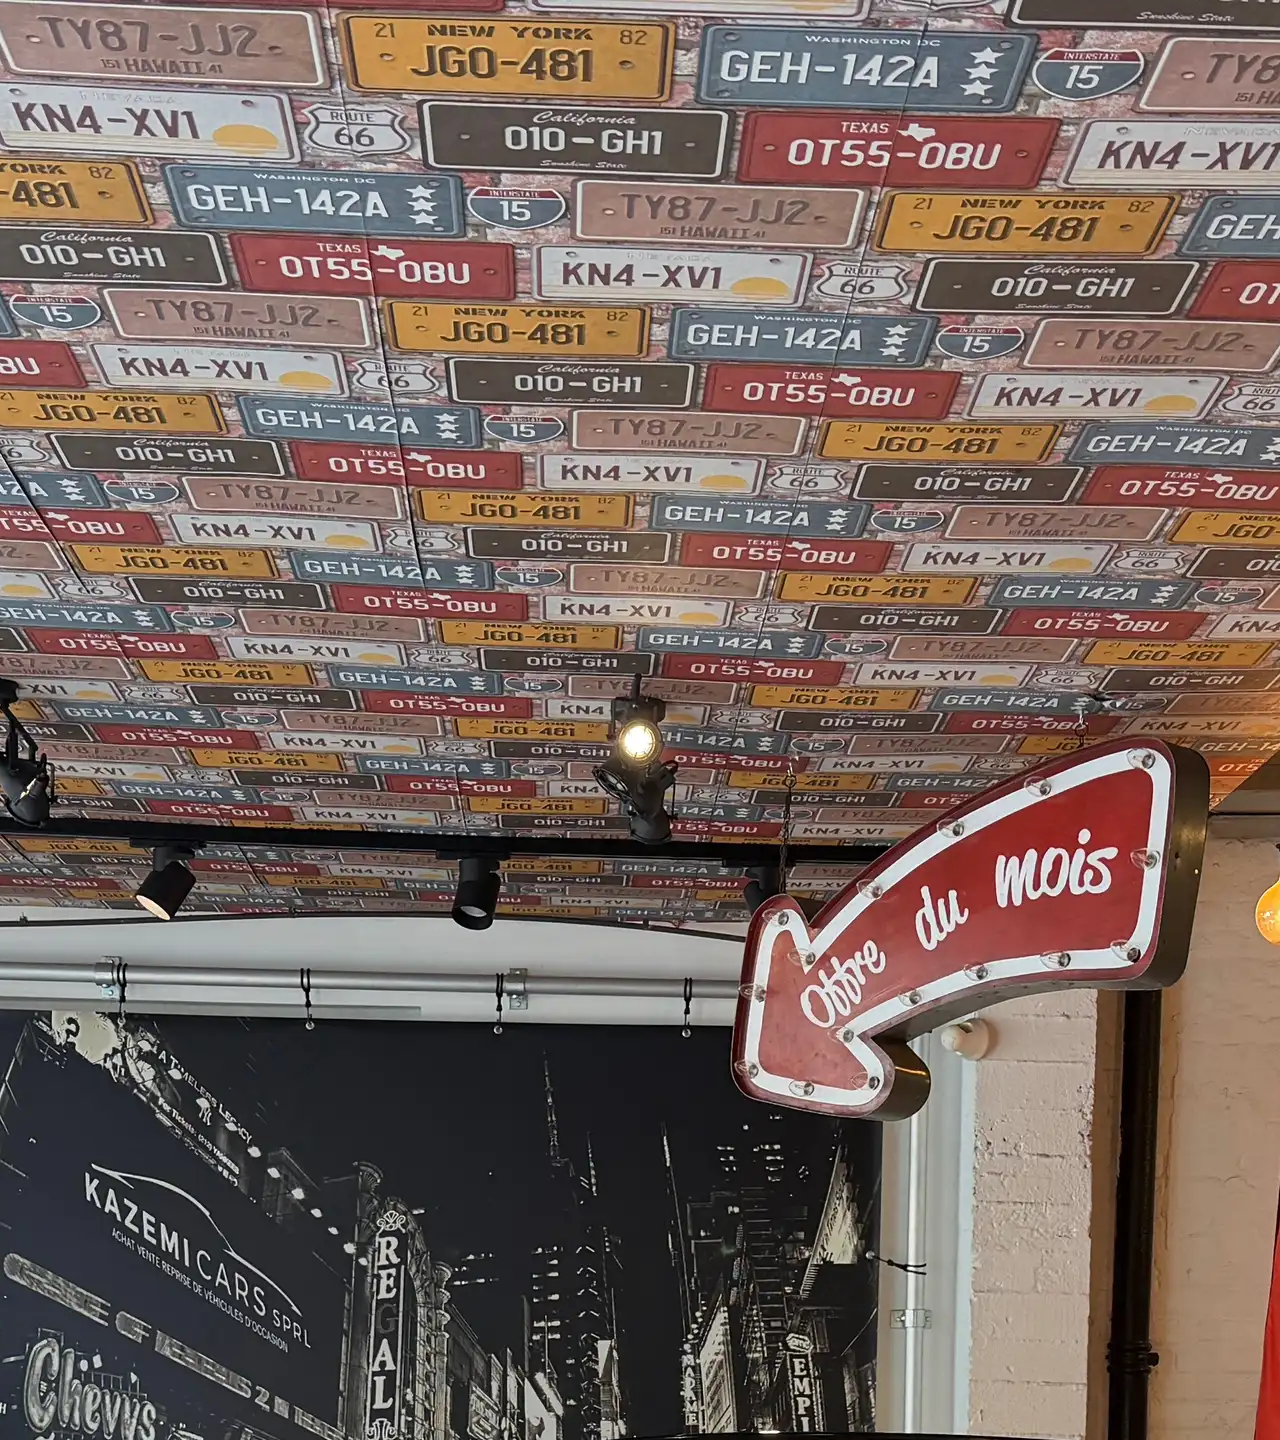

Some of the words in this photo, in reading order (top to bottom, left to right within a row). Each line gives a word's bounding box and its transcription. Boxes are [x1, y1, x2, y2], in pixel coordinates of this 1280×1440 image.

[38, 15, 263, 59] TY87-JJ2
[374, 21, 395, 38] 21
[427, 23, 495, 38] NEW
[511, 26, 594, 41] YORK
[621, 29, 648, 45] 82
[805, 34, 911, 46] WASHINGTON
[916, 38, 941, 48] DC
[411, 45, 594, 83] JGO-481
[1063, 49, 1119, 61] INTERSTATE
[719, 48, 939, 89] GEH-142A
[1065, 64, 1103, 90] 15
[330, 111, 371, 123] ROUTE
[533, 111, 635, 125] California
[840, 119, 889, 134] TEXAS
[334, 126, 375, 148] 66
[254, 173, 349, 183] WASHINGTON
[354, 176, 376, 185] DC
[187, 184, 389, 218] GEH-142A
[498, 200, 531, 221] 15
[621, 192, 811, 227] TY87-JJ2
[960, 197, 1022, 209] NEW
[1036, 199, 1107, 211] YORK
[40, 231, 131, 243] California
[931, 213, 1102, 244] JGO-481
[315, 241, 361, 253] TEXAS
[839, 278, 875, 295] 66
[440, 320, 586, 346] JGO-481
[686, 324, 861, 351] GEH-142A
[913, 884, 970, 951] du
[994, 827, 1119, 909] mois
[84, 1171, 191, 1268] KAZEMI
[196, 1249, 267, 1318] CARS
[272, 1308, 312, 1349] SPRL
[111, 1227, 136, 1251] ACHAT
[136, 1243, 161, 1269] VENTE
[161, 1260, 192, 1290] REPRISE
[193, 1280, 203, 1297] DE
[371, 1235, 403, 1410] REGAL
